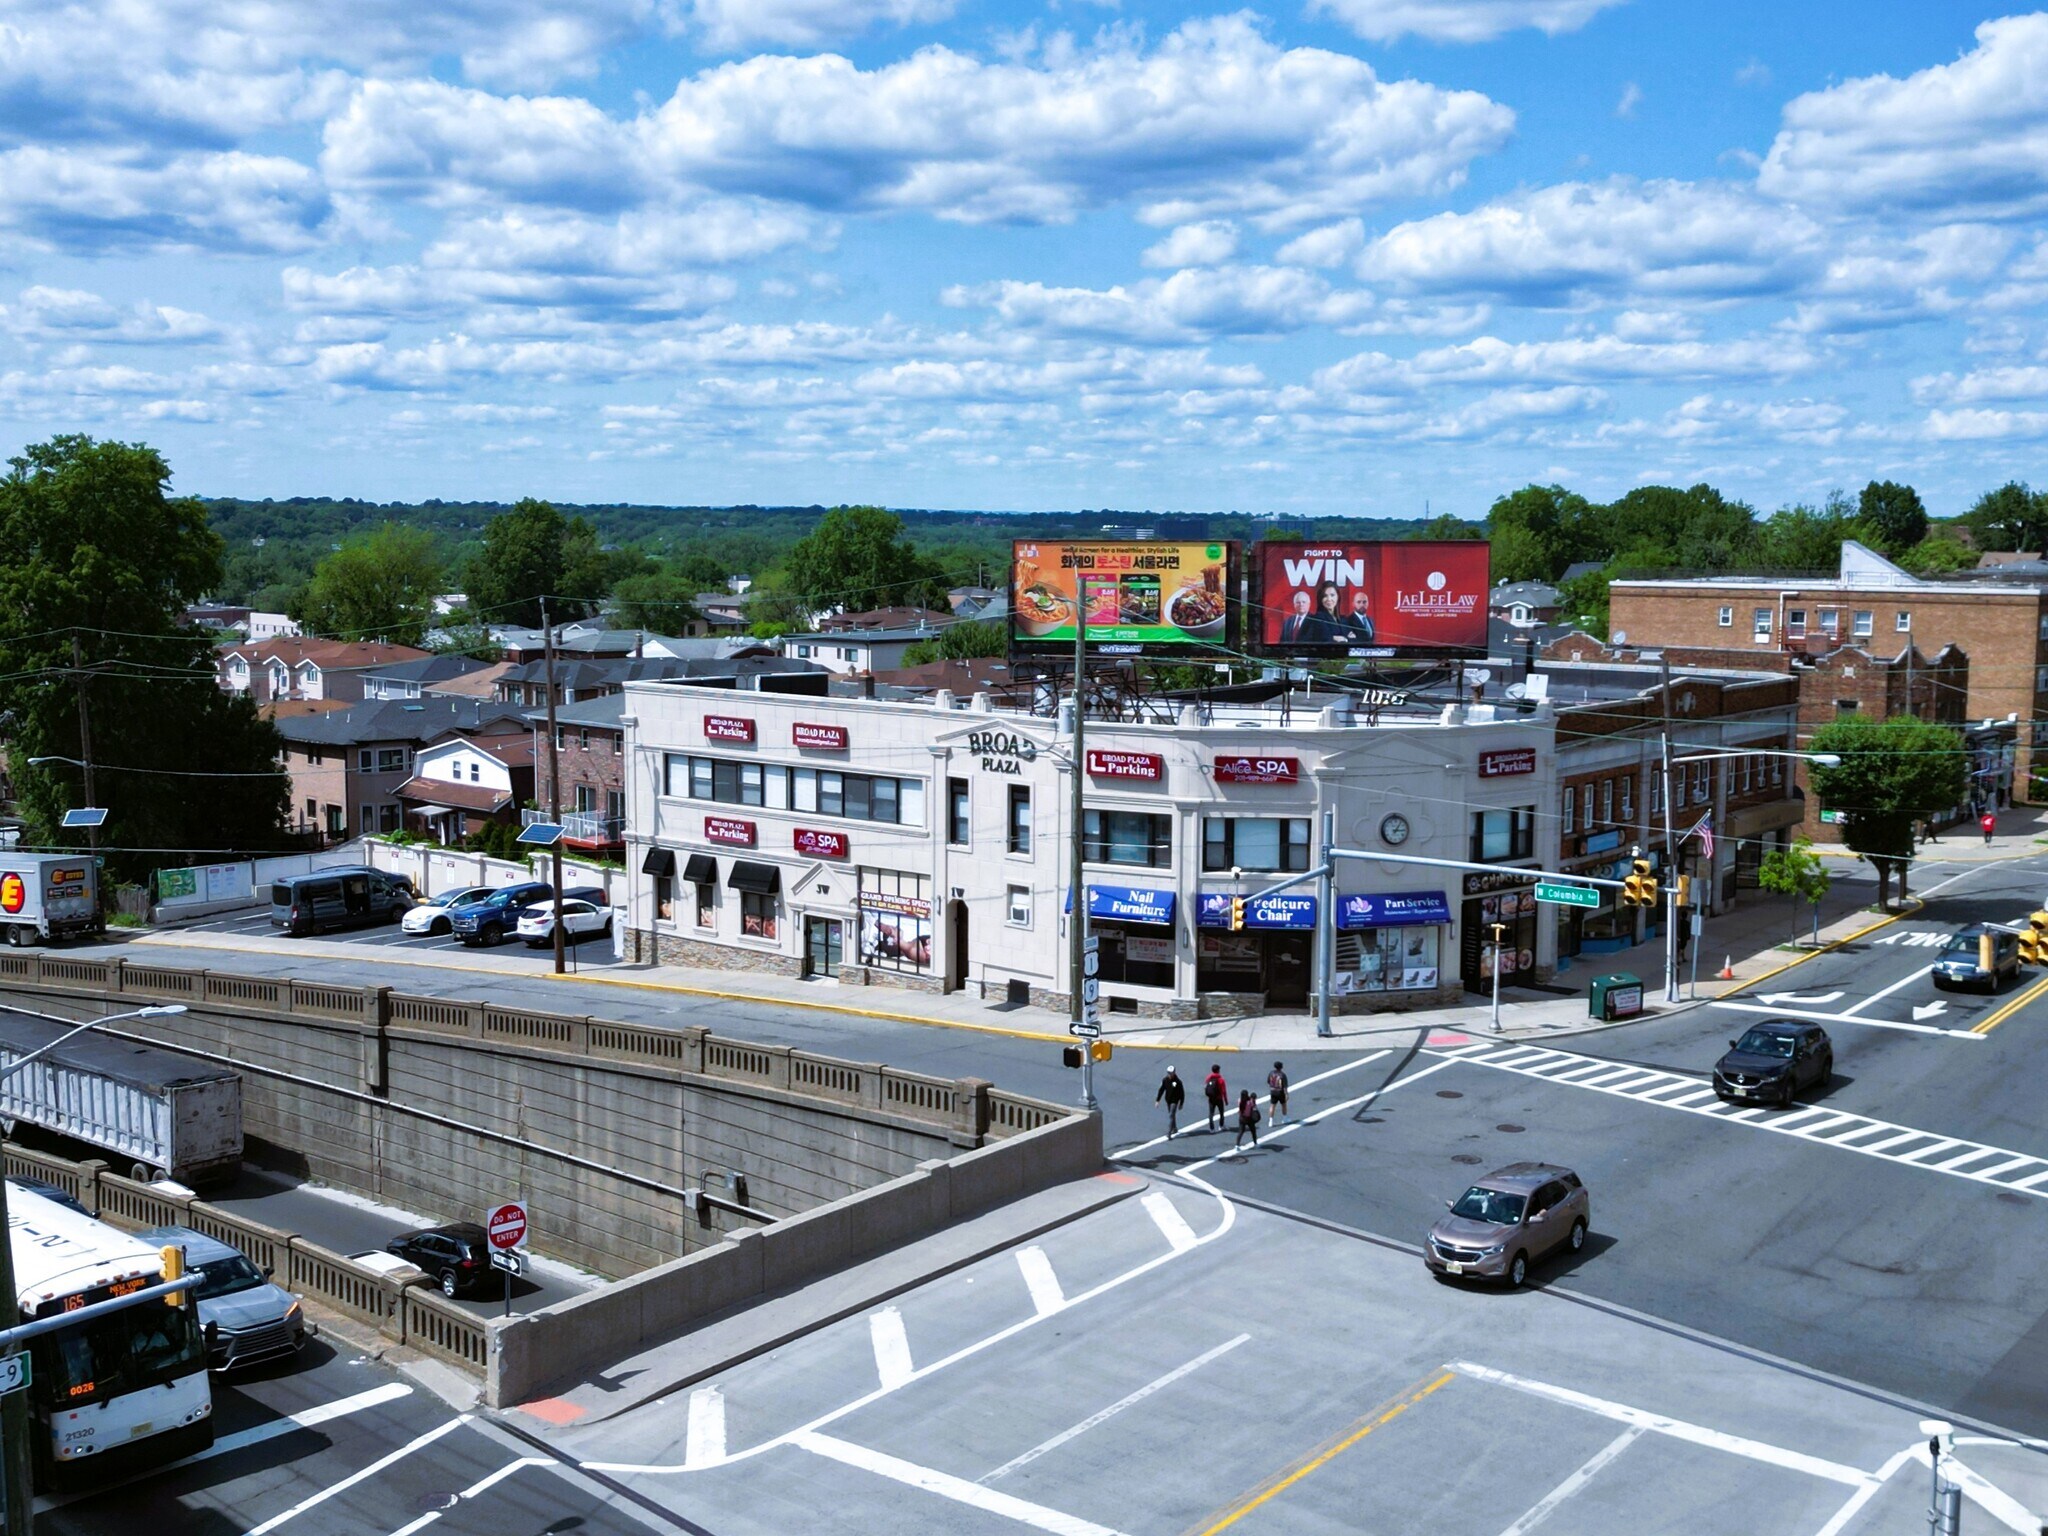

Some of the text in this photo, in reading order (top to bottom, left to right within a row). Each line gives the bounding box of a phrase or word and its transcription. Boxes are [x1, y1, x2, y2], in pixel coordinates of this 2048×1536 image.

[1304, 549, 1342, 557] FIGHT TO
[1132, 555, 1180, 569] 서울라면
[1283, 559, 1364, 587] WIN
[727, 720, 744, 728] PLAZA
[718, 726, 748, 740] Parking
[796, 727, 840, 740] BROAD PLAZA
[982, 757, 1022, 775] PLAZA
[1101, 754, 1150, 765] BROAD PLAZA
[1108, 763, 1156, 777] Parking
[1222, 760, 1290, 775] Alice SPA
[1499, 761, 1532, 773] Parking
[711, 820, 745, 831] BROAD PLAZA
[719, 827, 749, 842] Parking
[817, 834, 839, 849] SPA
[1, 879, 21, 905] E
[1128, 890, 1155, 904] Nail
[1547, 888, 1583, 901] Columbia
[860, 892, 931, 908] GRAND OPENING SPECIA
[1384, 897, 1440, 909] Part Service
[1111, 900, 1166, 917] Furniture
[1256, 908, 1293, 921] Chair
[1873, 931, 1953, 948] NLY
[1088, 983, 1095, 997] 9
[493, 1210, 521, 1224] DO NOT
[496, 1230, 519, 1243] ENTER
[63, 1278, 147, 1313] 165 NEW YORK
[65, 1427, 95, 1441] 21320
